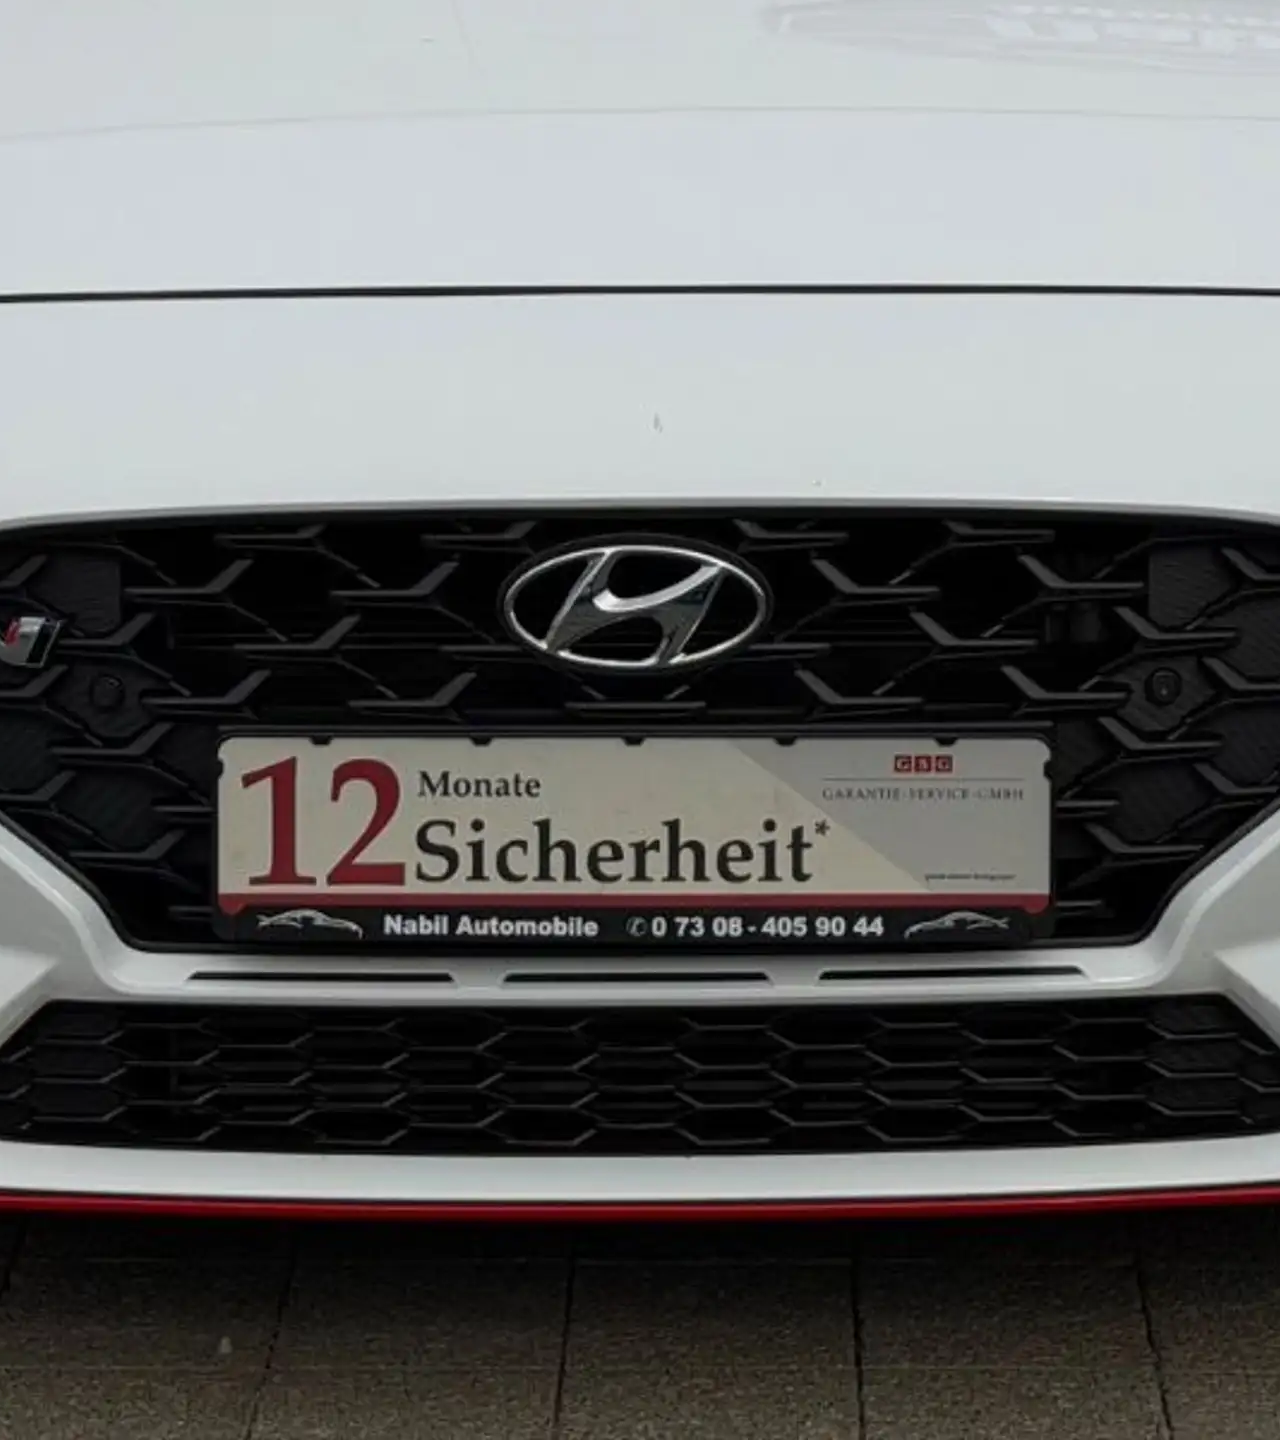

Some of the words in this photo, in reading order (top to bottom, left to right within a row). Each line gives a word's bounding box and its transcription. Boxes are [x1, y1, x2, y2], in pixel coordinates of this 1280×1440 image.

[416, 770, 542, 798] Monate
[240, 755, 407, 887] 12
[383, 914, 450, 937] Nabil
[455, 914, 600, 937] Automobile
[673, 915, 706, 938] 73
[814, 915, 846, 938] 90
[852, 915, 885, 938] 44
